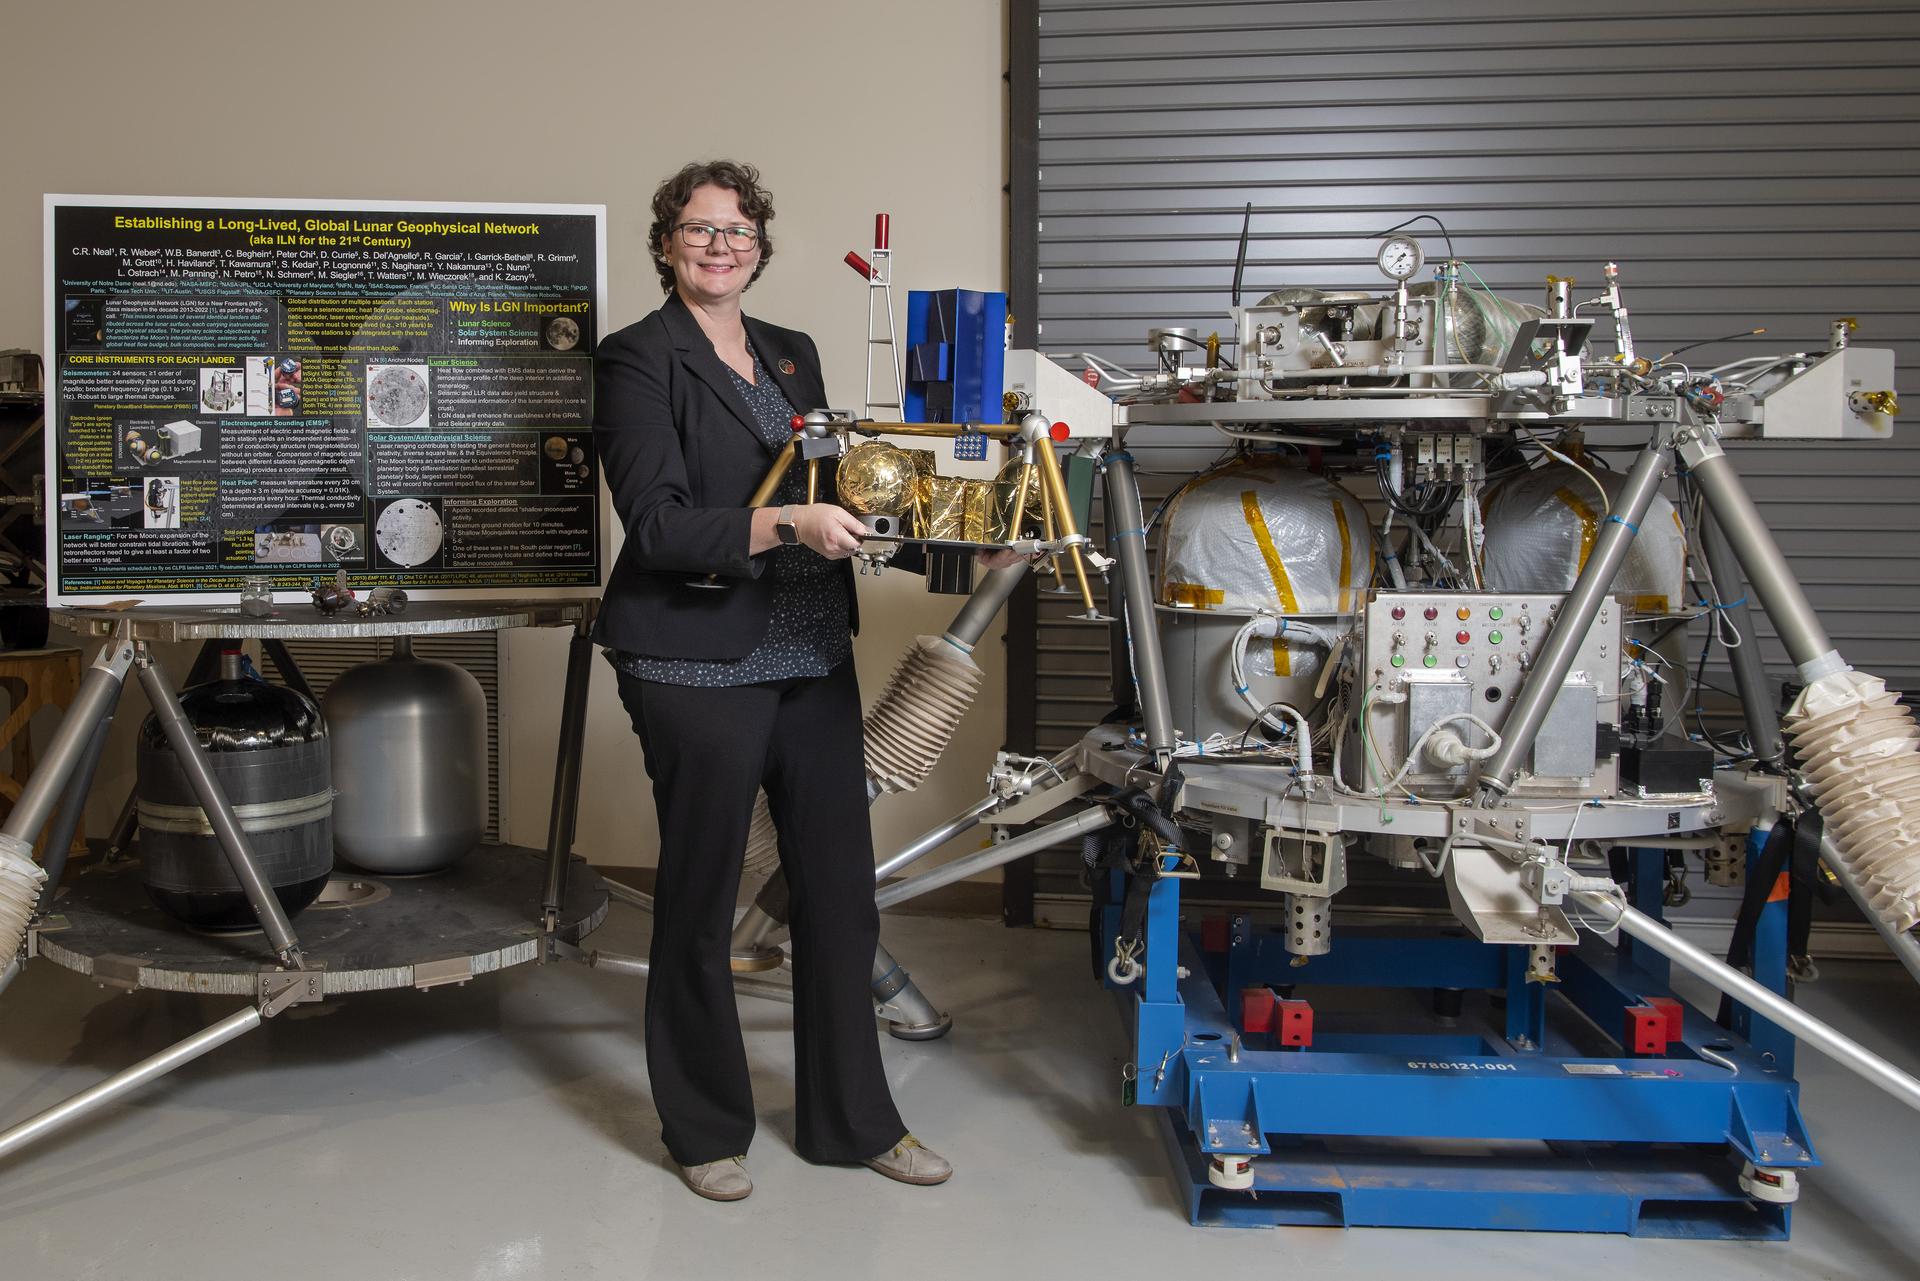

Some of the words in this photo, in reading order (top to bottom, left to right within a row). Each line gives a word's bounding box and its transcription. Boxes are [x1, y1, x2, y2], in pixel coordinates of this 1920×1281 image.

[115, 216, 202, 233] Establishing
[206, 220, 215, 230] a
[219, 217, 300, 234] Long-Lived,
[305, 219, 349, 232] Global
[354, 219, 393, 232] Lunar
[397, 220, 480, 236] Geophysical
[485, 221, 539, 234] Network
[249, 235, 273, 247] (aka
[277, 235, 296, 245] ILN
[299, 235, 316, 245] for
[318, 235, 336, 245] the
[363, 236, 411, 248] Century)
[72, 247, 90, 256] C.R.
[119, 248, 129, 257] R.
[165, 248, 184, 257] W.B.
[225, 249, 234, 258] C.
[320, 250, 329, 259] D.
[362, 251, 371, 260] S.
[424, 251, 433, 260] R.
[467, 252, 473, 261] I.
[537, 253, 546, 261] R.
[122, 258, 132, 267] M.
[166, 258, 175, 267] H.
[220, 259, 227, 268] T.
[281, 260, 290, 268] S.
[323, 260, 330, 269] P.
[381, 261, 390, 269] S.
[437, 261, 444, 270] Y.
[496, 262, 505, 271] C.
[117, 268, 125, 277] L.
[170, 269, 180, 277] M.
[222, 269, 232, 278] N.
[266, 270, 275, 278] N.
[318, 270, 328, 279] M.
[368, 271, 375, 279] T.
[417, 271, 426, 280] M.
[495, 272, 504, 280] K.
[449, 301, 477, 314] Why
[480, 301, 491, 312] Is
[494, 301, 520, 312] LGN
[524, 302, 589, 315] Important?
[479, 329, 508, 338] System
[457, 338, 495, 347] Informing
[495, 338, 538, 347] Exploration
[63, 378, 95, 386] magnitude
[115, 378, 144, 386] sensitivity
[176, 378, 197, 386] during
[63, 385, 85, 393] Apollo;
[110, 385, 141, 393] frequency
[388, 434, 463, 442] System/Astrophysical
[288, 479, 323, 487] temperature
[160, 532, 190, 540] expansion
[1408, 1062, 1516, 1071] 6780121-001
